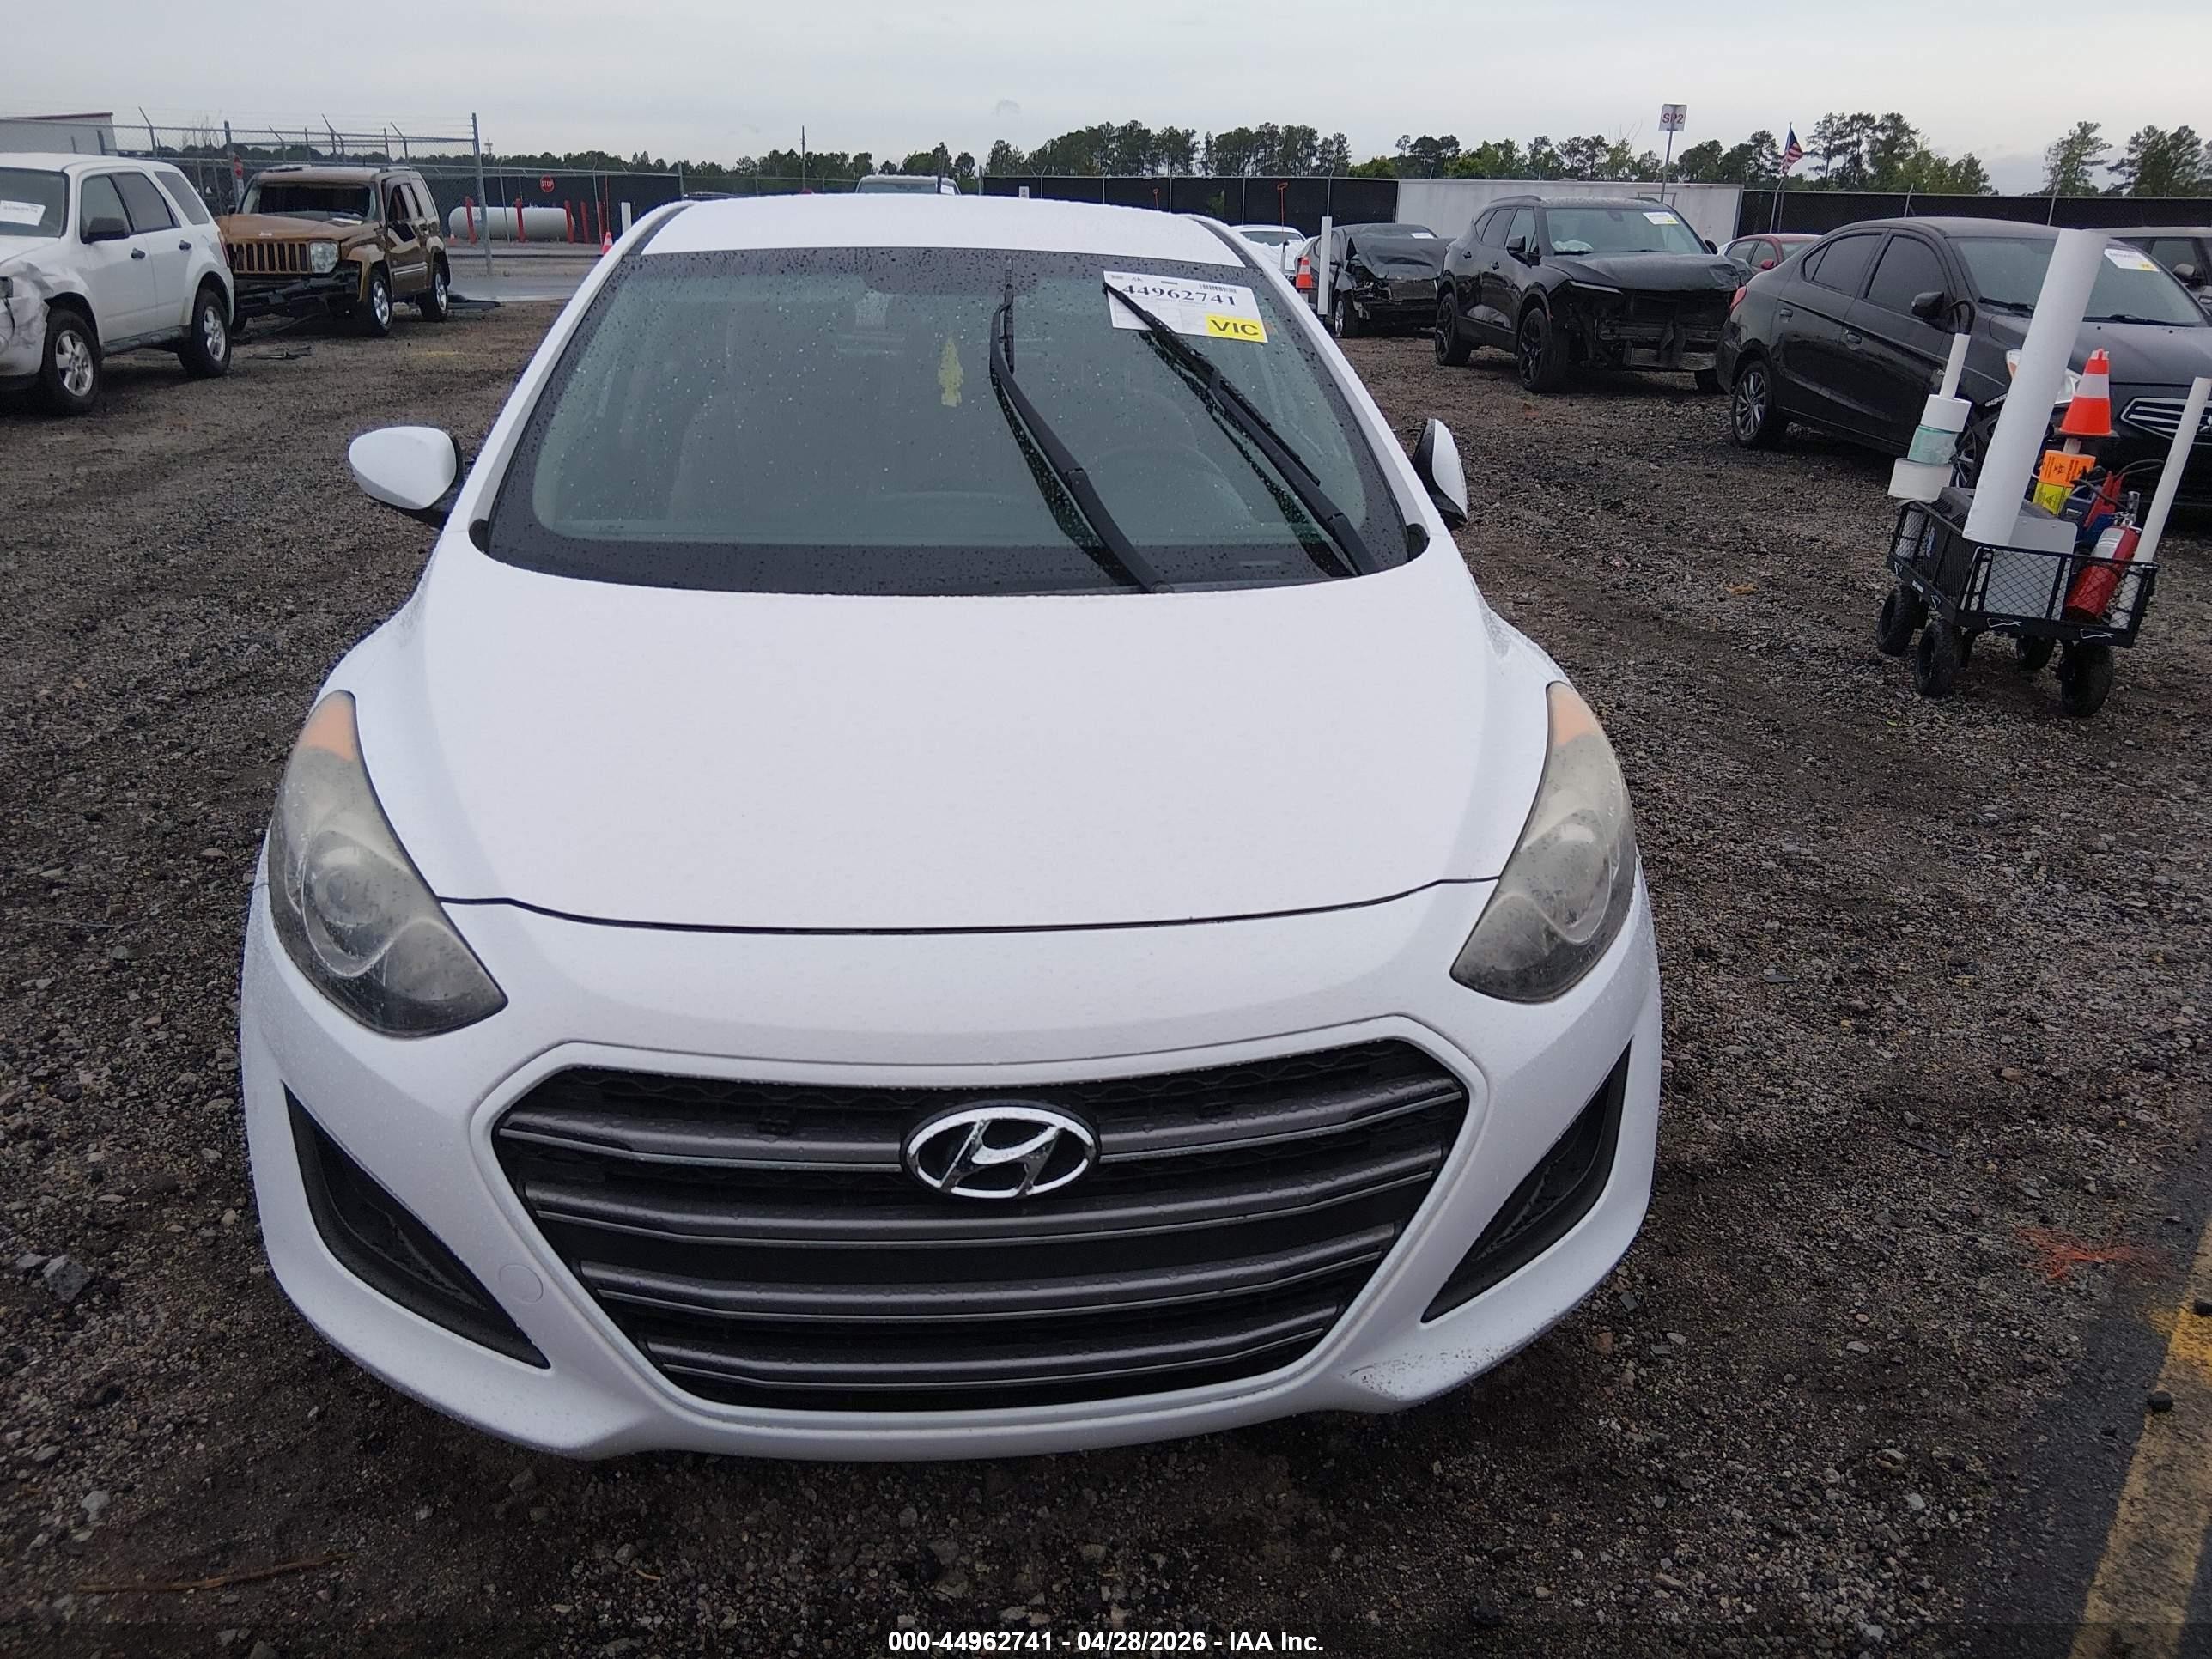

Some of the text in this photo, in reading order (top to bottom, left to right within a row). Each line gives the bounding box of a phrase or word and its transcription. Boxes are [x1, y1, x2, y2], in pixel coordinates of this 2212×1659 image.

[1662, 112, 1684, 124] SP2
[1122, 284, 1236, 307] 44962741
[1211, 319, 1259, 336] VIC
